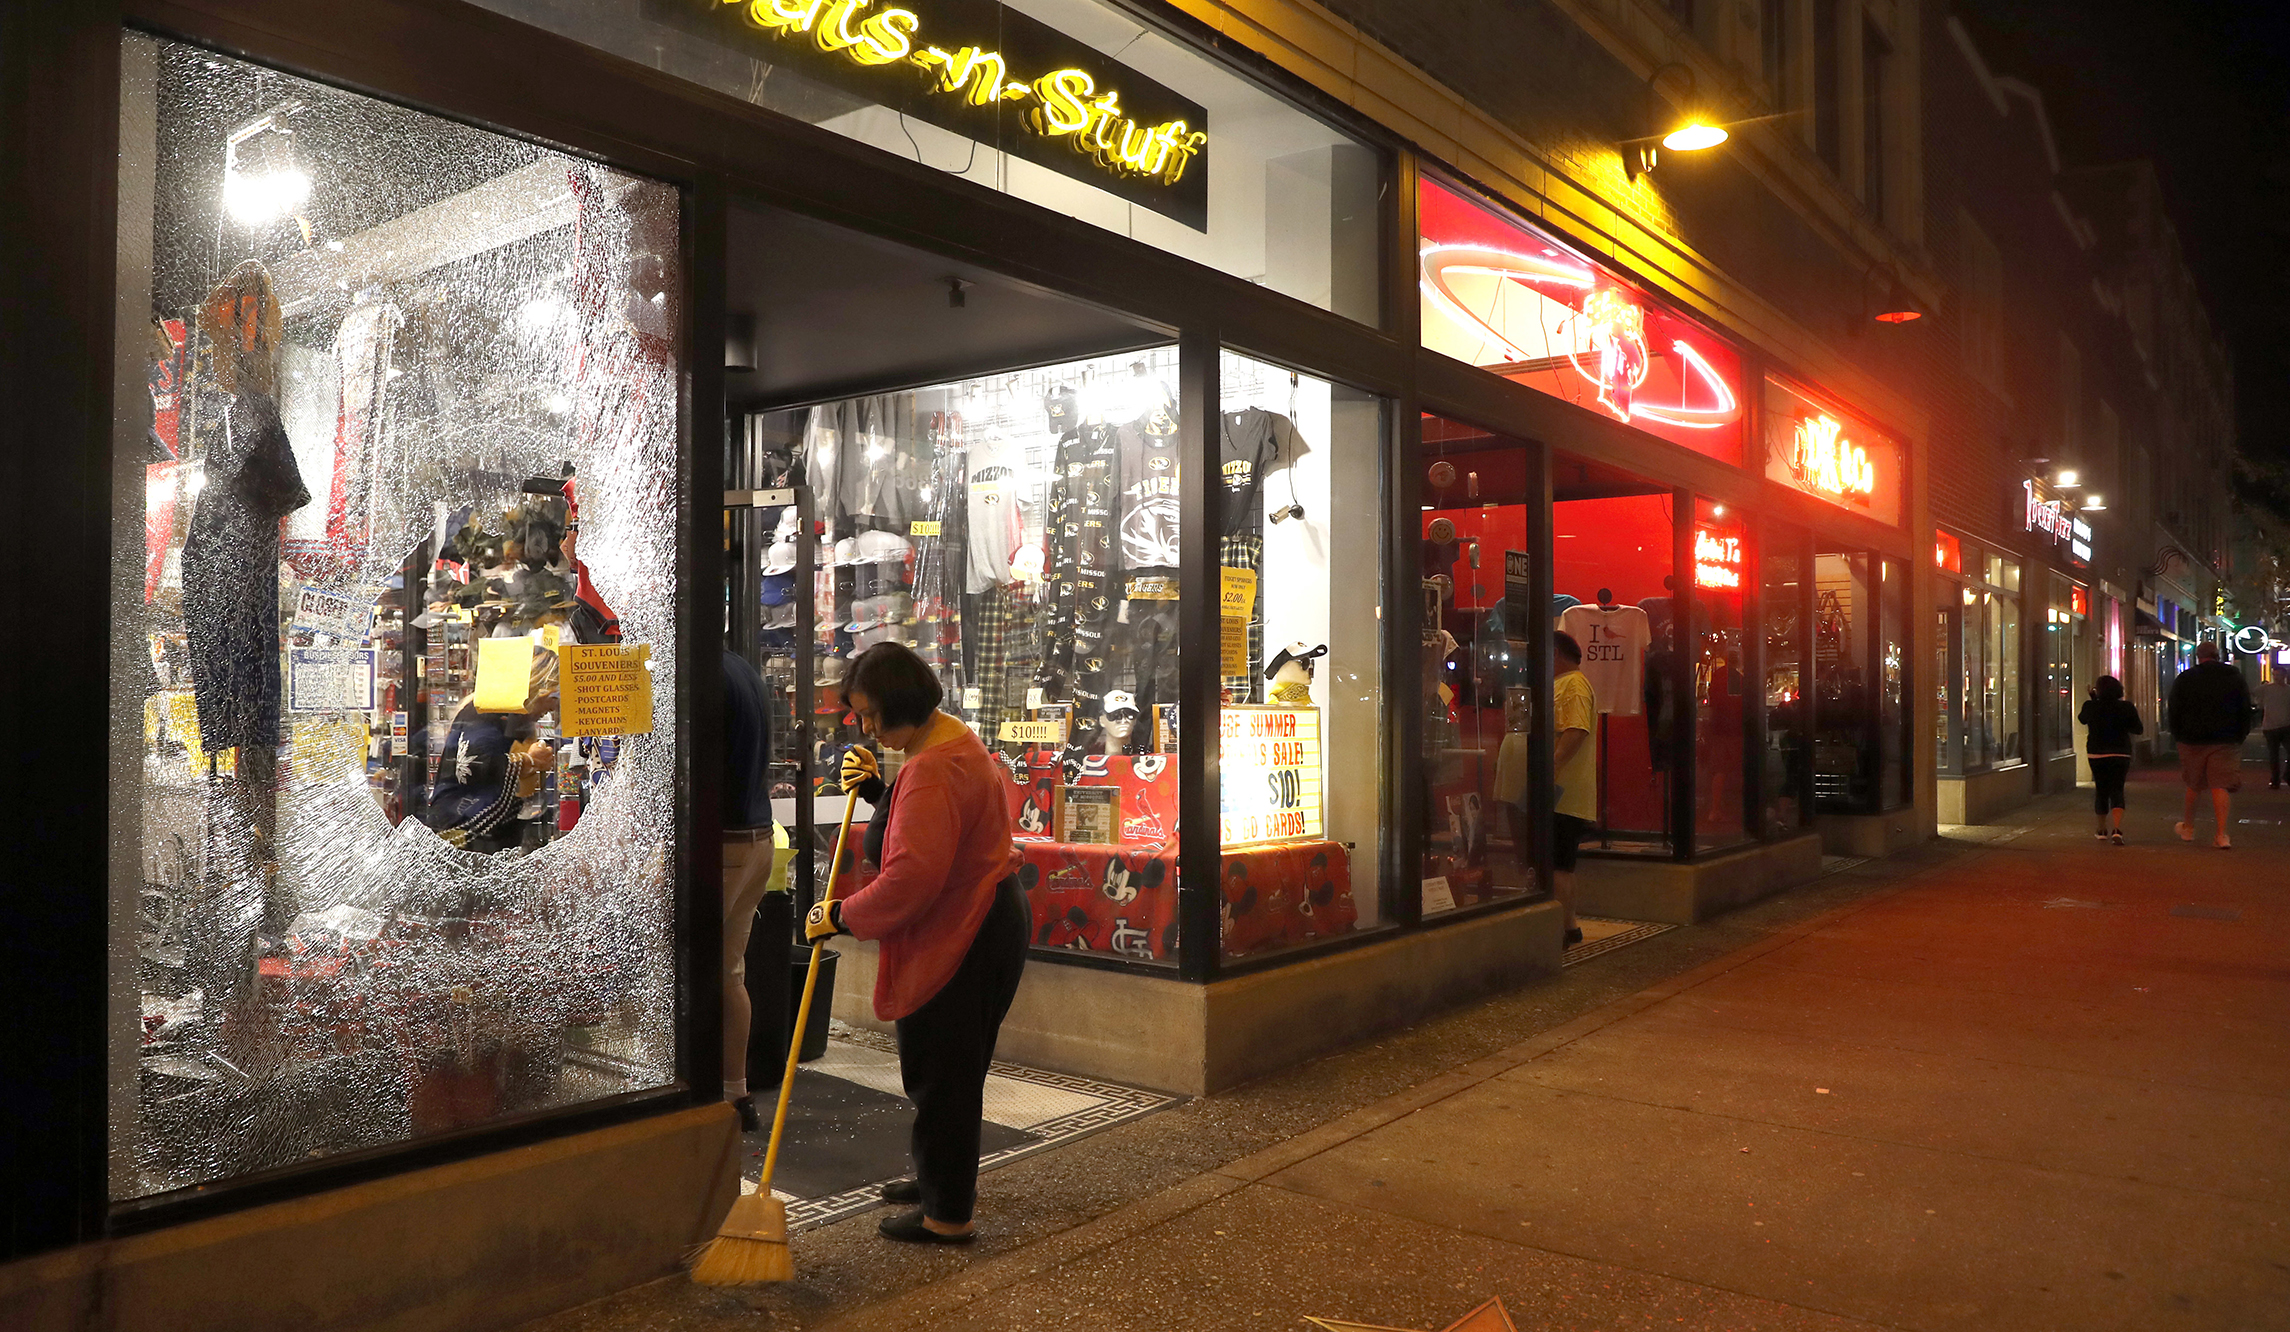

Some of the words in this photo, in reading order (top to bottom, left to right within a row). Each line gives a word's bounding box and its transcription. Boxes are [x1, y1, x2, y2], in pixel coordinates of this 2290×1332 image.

[1590, 624, 1600, 643] I
[582, 649, 597, 658] ST.
[600, 648, 630, 657] LOUIS
[1587, 645, 1624, 661] STL
[574, 660, 639, 671] SOUVENIERS
[573, 675, 597, 683] $5.00
[598, 674, 617, 682] AND
[619, 673, 638, 681] LESS
[603, 684, 640, 692] GLASSES
[1011, 725, 1047, 740] $10!!!!
[1250, 714, 1296, 738] SUMMER
[1273, 742, 1304, 766] SALE!
[1266, 811, 1305, 838] CARDS!
